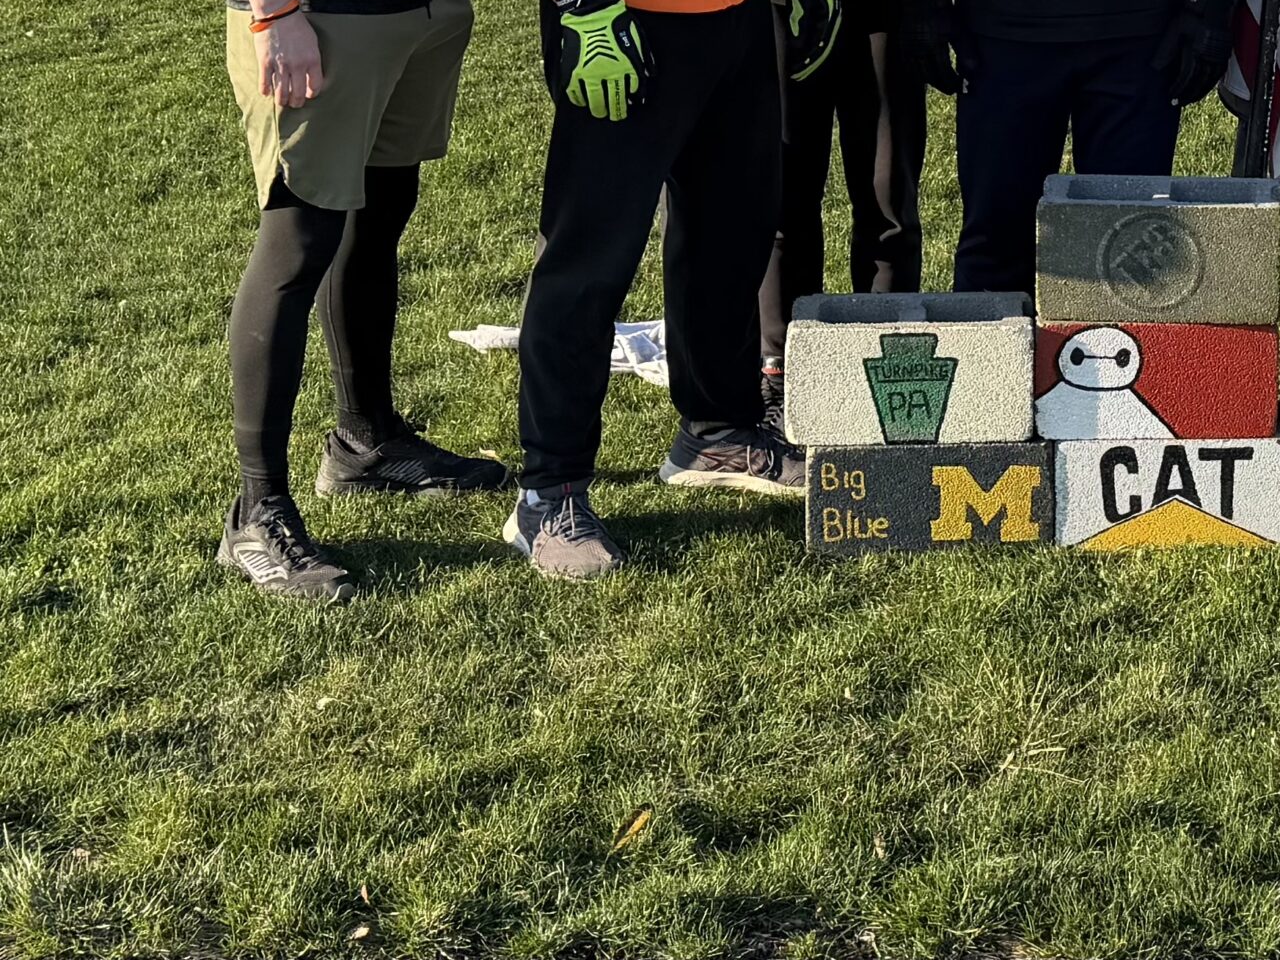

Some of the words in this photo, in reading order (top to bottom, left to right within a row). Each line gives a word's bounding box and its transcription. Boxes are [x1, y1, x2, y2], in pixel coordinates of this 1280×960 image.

[870, 363, 950, 379] TURNPIKE
[888, 390, 932, 423] PA
[820, 462, 867, 500] Big
[1100, 445, 1254, 524] CAT
[930, 465, 1042, 543] M
[821, 506, 890, 543] Blue
